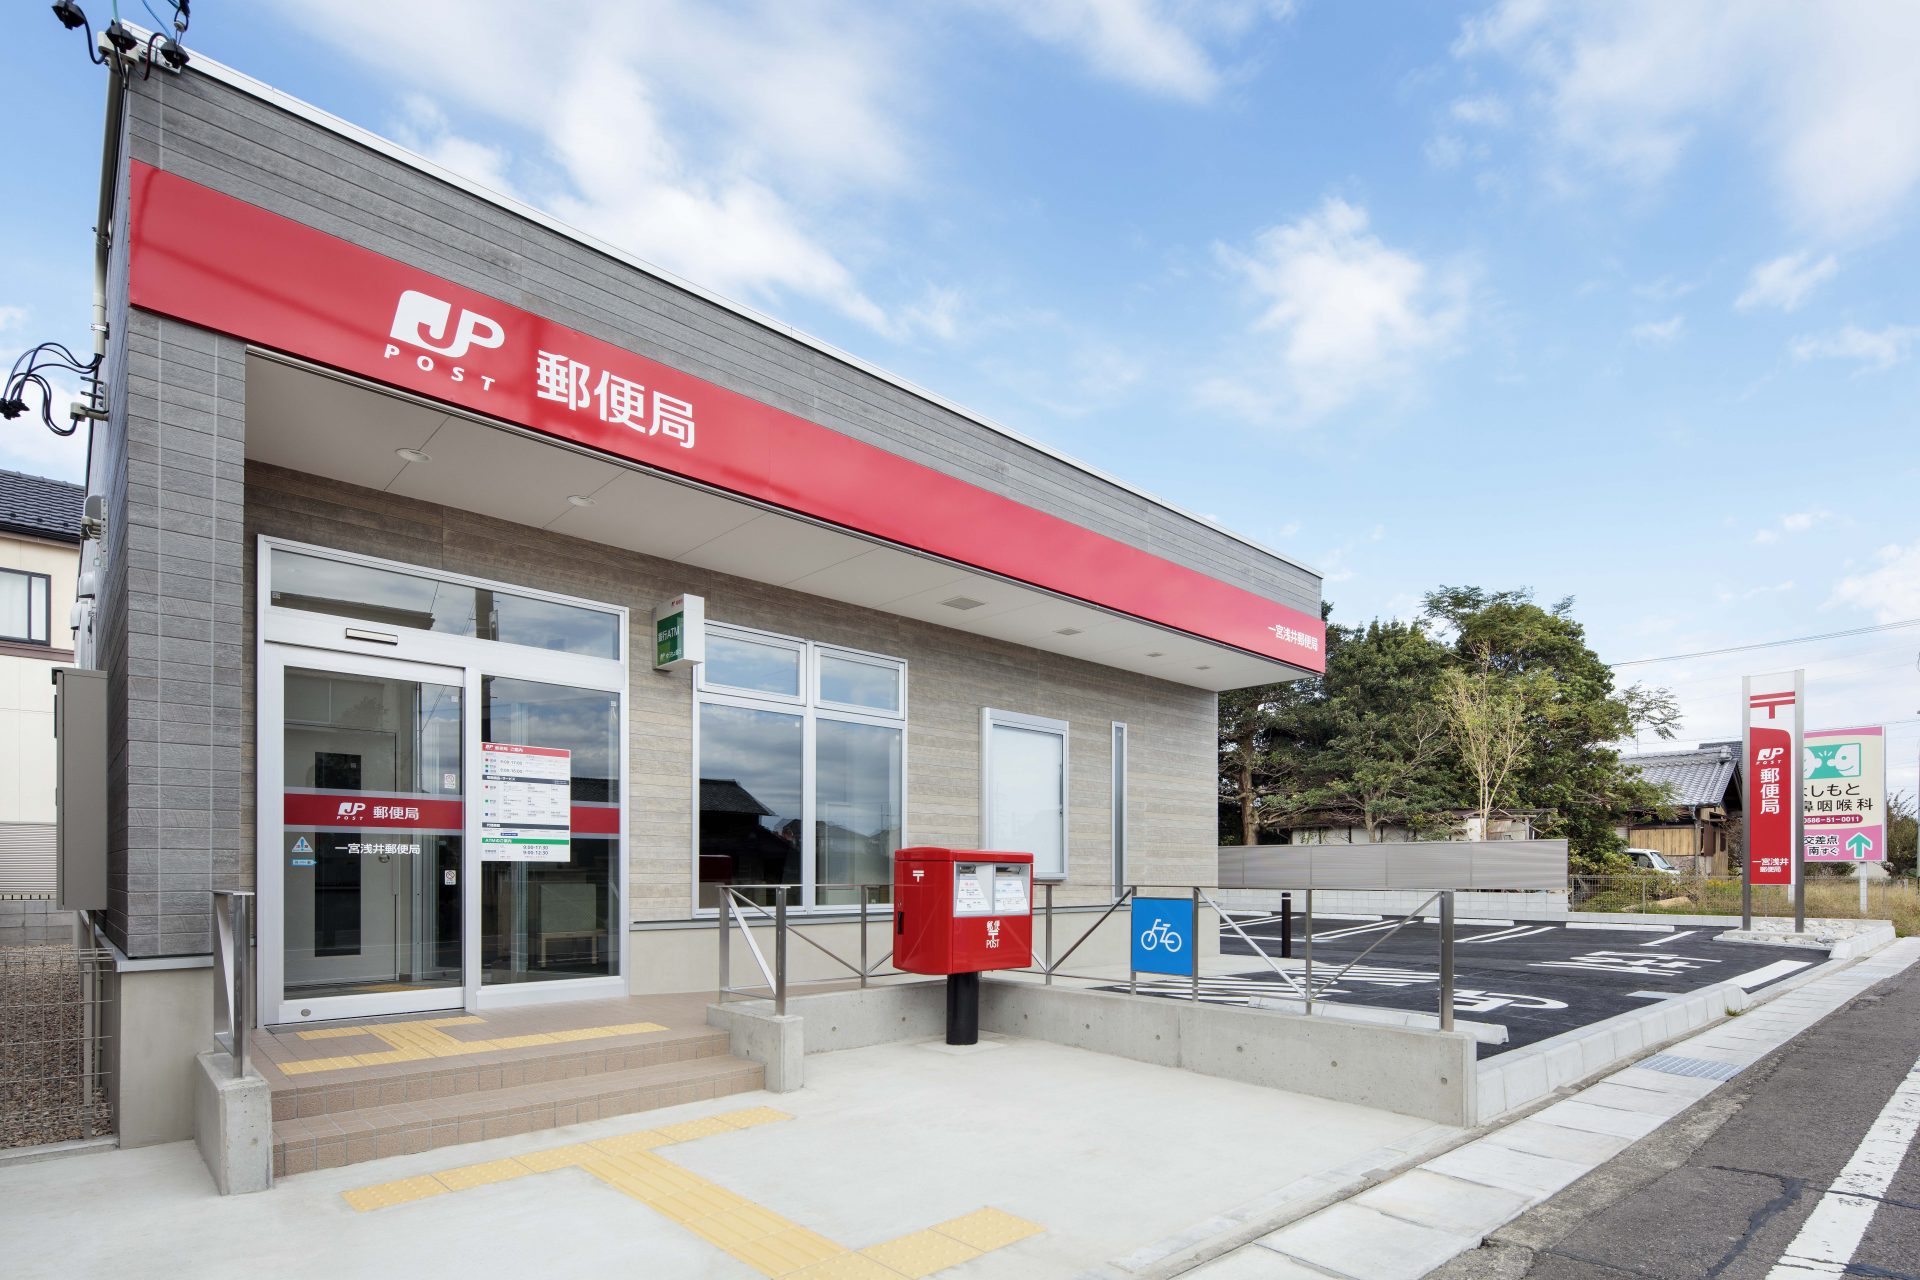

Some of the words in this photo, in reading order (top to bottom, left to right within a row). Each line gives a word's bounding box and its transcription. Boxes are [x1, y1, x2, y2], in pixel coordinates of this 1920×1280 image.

[390, 289, 505, 358] JP
[384, 344, 495, 392] POST
[536, 349, 695, 449] 郵便局
[1267, 624, 1318, 652] 一宮浅井郵便局
[1757, 748, 1784, 760] JP
[1760, 767, 1780, 815] 郵便局
[337, 802, 366, 816] JP
[373, 806, 419, 821] 郵便局
[334, 843, 420, 855] 一宮浅井郵便局
[1808, 846, 1838, 855] 南すぐ
[1752, 858, 1789, 866] 一宮浅井
[986, 939, 1000, 948] POST
